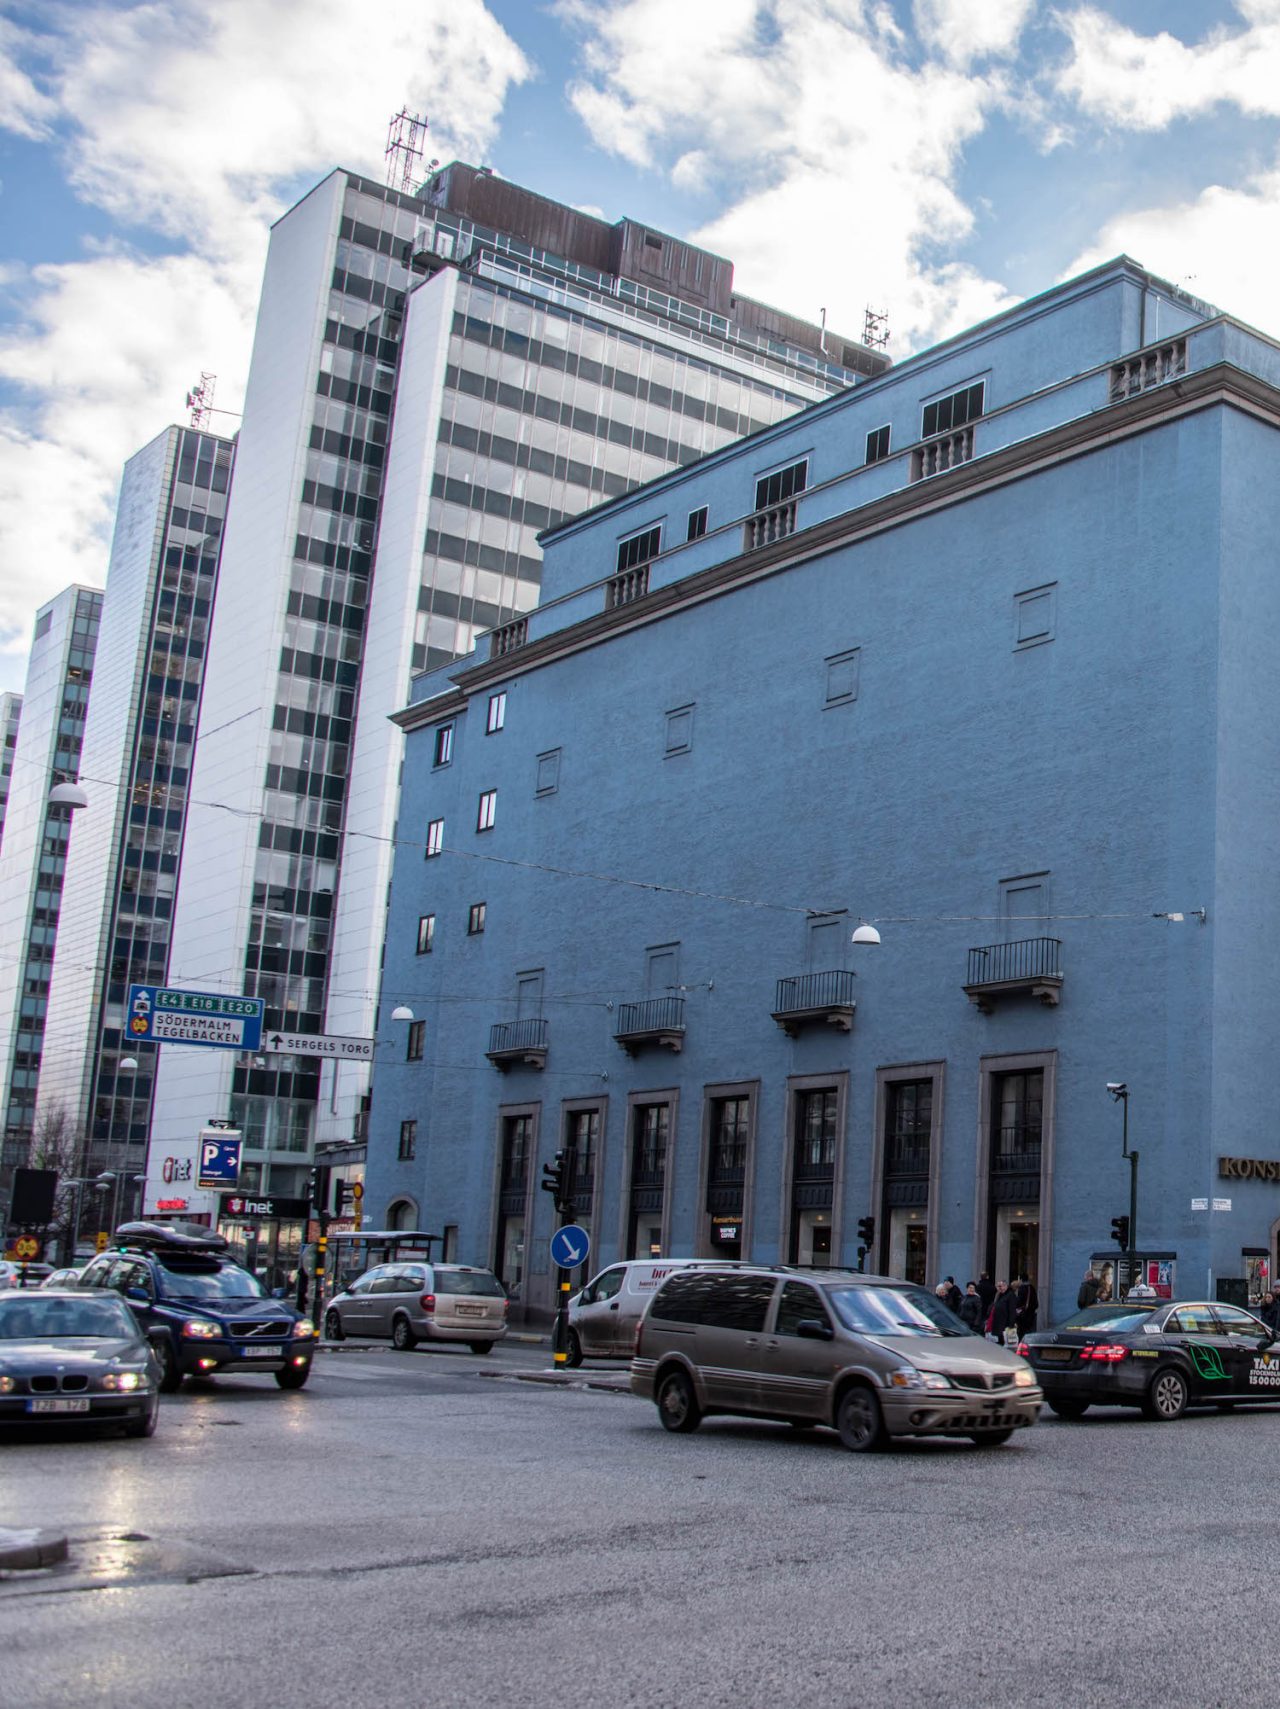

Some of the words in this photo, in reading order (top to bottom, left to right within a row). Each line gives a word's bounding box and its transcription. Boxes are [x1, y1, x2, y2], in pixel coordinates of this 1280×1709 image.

[162, 994, 177, 1005] E4
[192, 998, 213, 1009] E18
[228, 1003, 253, 1014] E20
[157, 1014, 231, 1031] SÖDERMALM
[156, 1026, 240, 1043] TEGELBACKEN
[288, 1039, 336, 1052] SERGELS
[341, 1043, 370, 1054] TORG
[203, 1145, 219, 1166] P
[244, 1199, 273, 1214] Inet
[1253, 1357, 1280, 1371] TAXI
